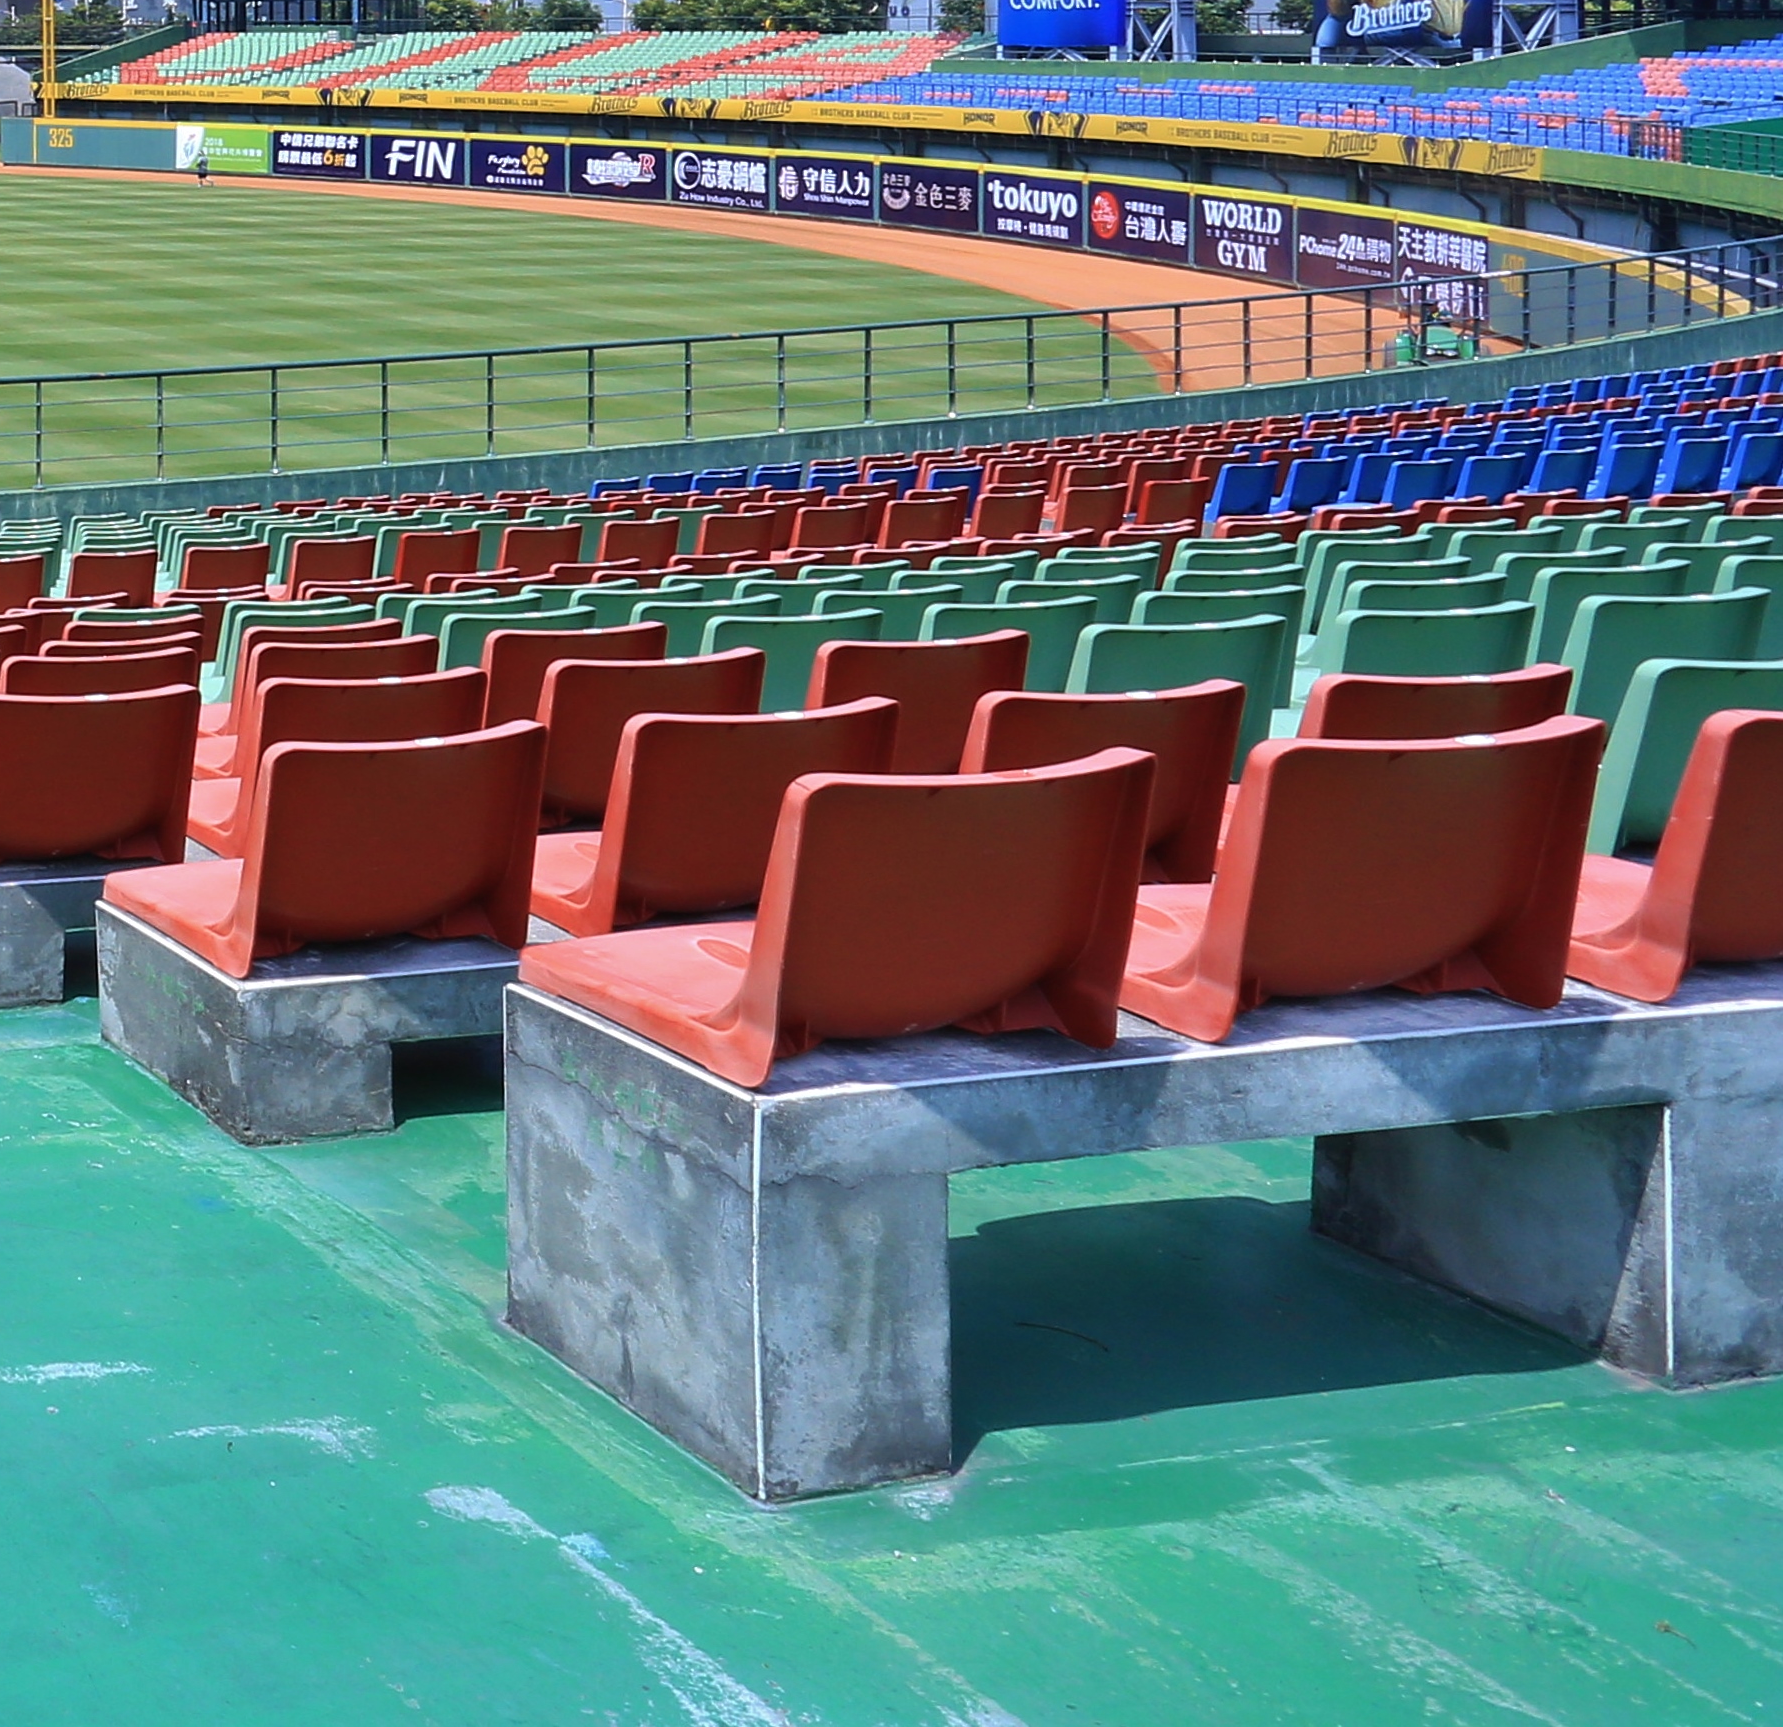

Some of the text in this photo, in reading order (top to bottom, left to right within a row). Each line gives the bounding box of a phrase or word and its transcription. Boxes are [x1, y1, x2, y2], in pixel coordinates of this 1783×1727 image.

[198, 89, 215, 98] CLUB
[454, 96, 486, 105] BROTHERS
[522, 98, 539, 107] CLUB
[820, 108, 854, 118] BROTHERS
[856, 109, 891, 120] BASEBALL
[892, 111, 911, 121] CLUB
[49, 129, 74, 148] 325
[1176, 128, 1212, 139] BROTHERS
[1213, 130, 1250, 142] BASEBALL
[1251, 132, 1270, 143] CLUB
[384, 139, 456, 179] FIN
[803, 167, 870, 197] 守信人力
[914, 182, 972, 211] 金色三麥
[706, 194, 733, 207] Industry
[988, 179, 1078, 221] tokuyo
[1125, 214, 1187, 246] 台灣人壽
[1202, 199, 1282, 234] WORLD
[1217, 239, 1267, 272] GYM
[1299, 234, 1336, 258] PChome
[1398, 226, 1487, 273] 天主教耕莘醫院
